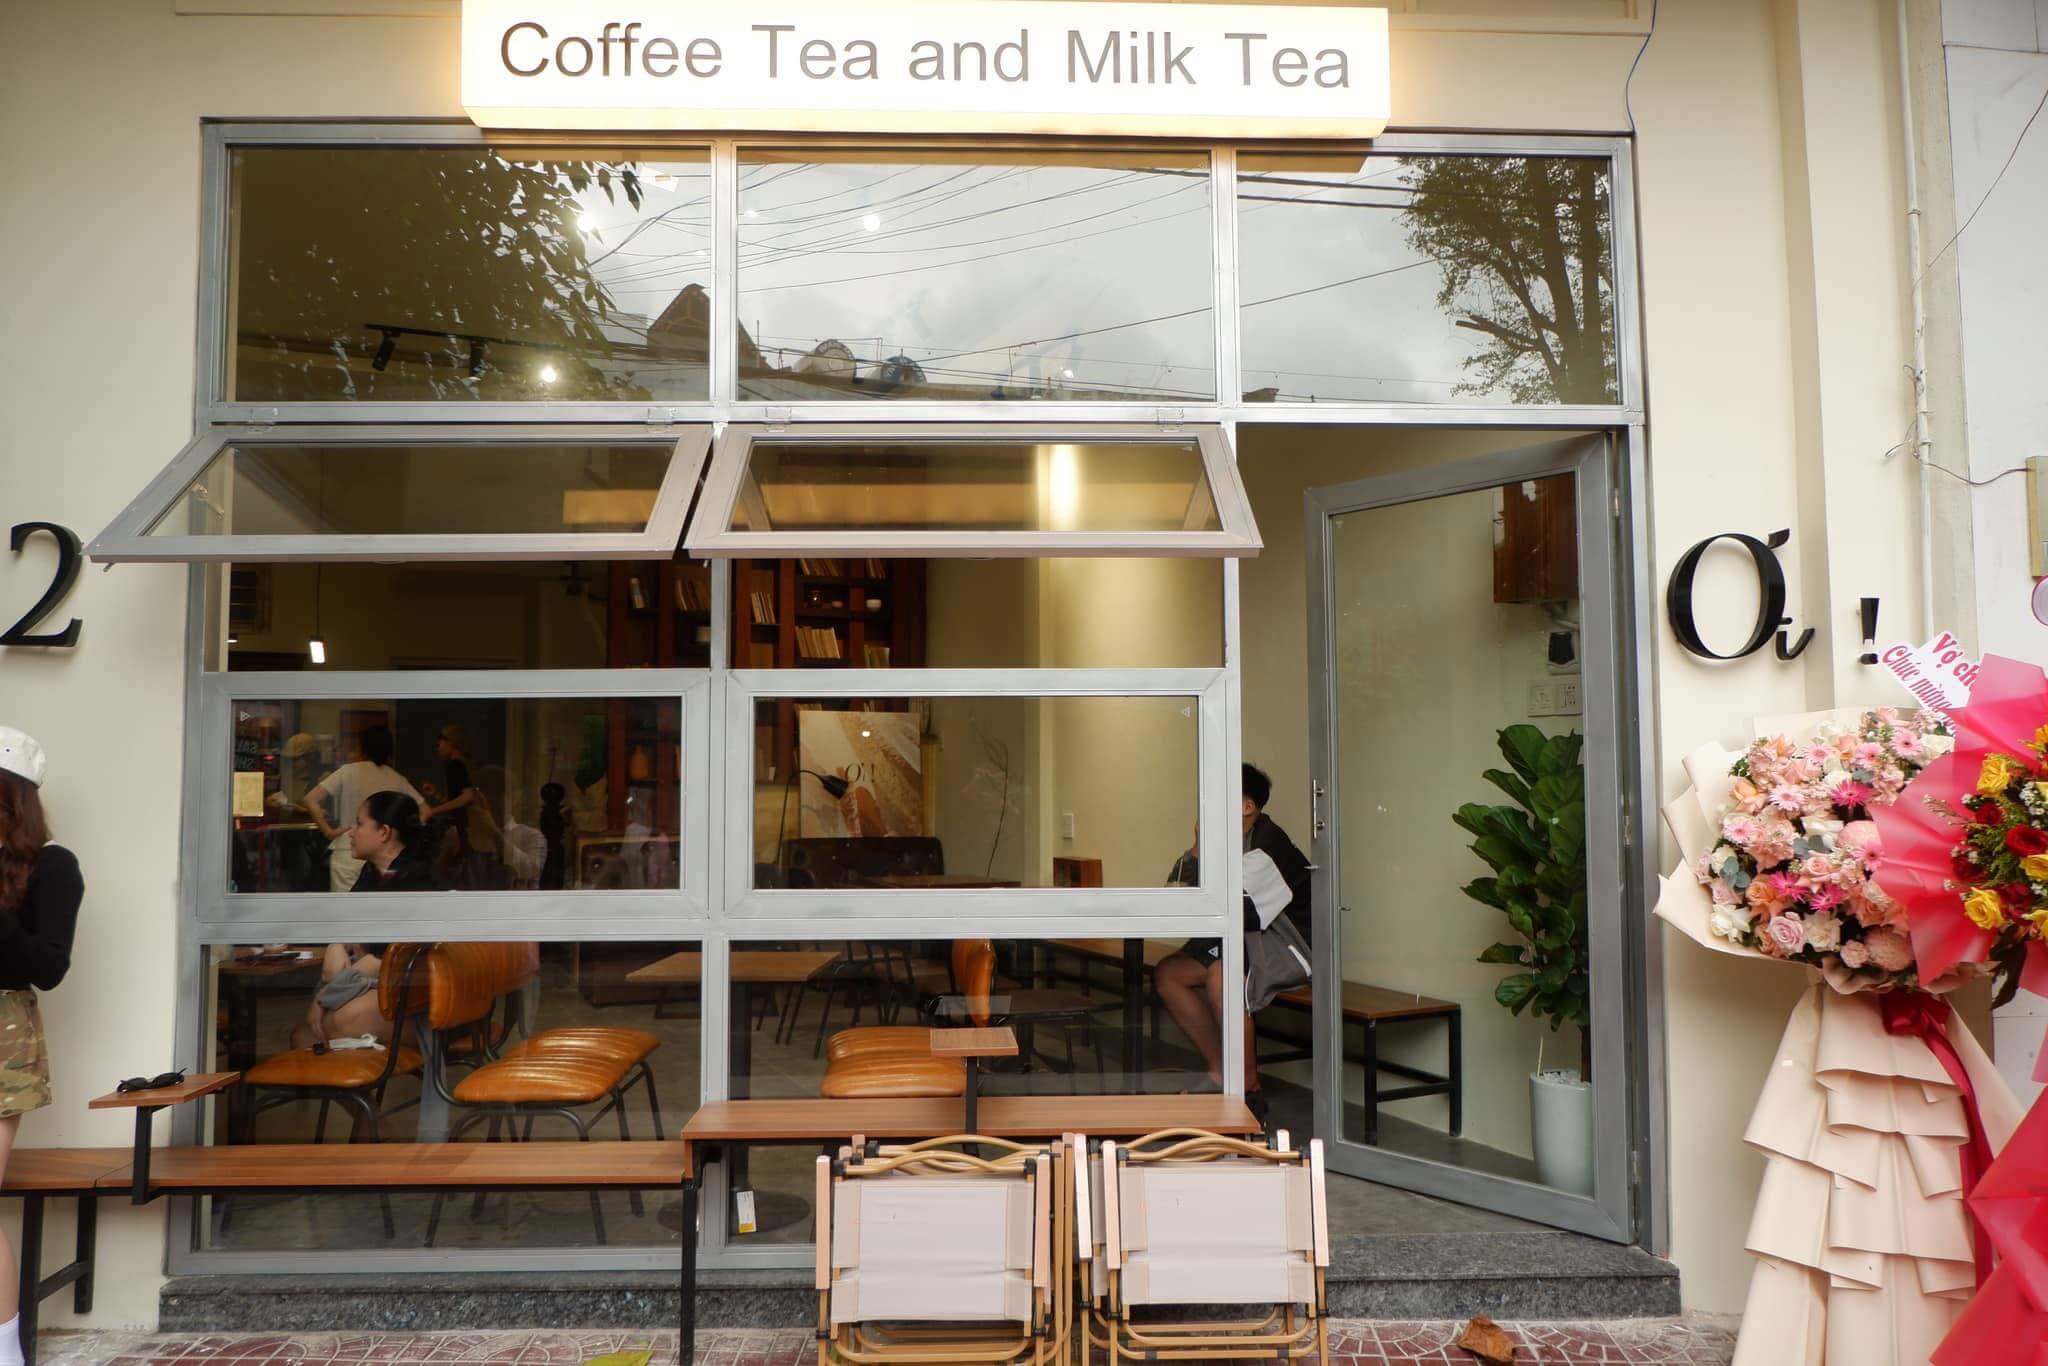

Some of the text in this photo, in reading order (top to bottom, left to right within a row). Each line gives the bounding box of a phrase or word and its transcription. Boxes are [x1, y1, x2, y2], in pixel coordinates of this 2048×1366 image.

[500, 21, 1349, 88] Coffee Tea and Milk Tea
[1952, 662, 1980, 687] ch
